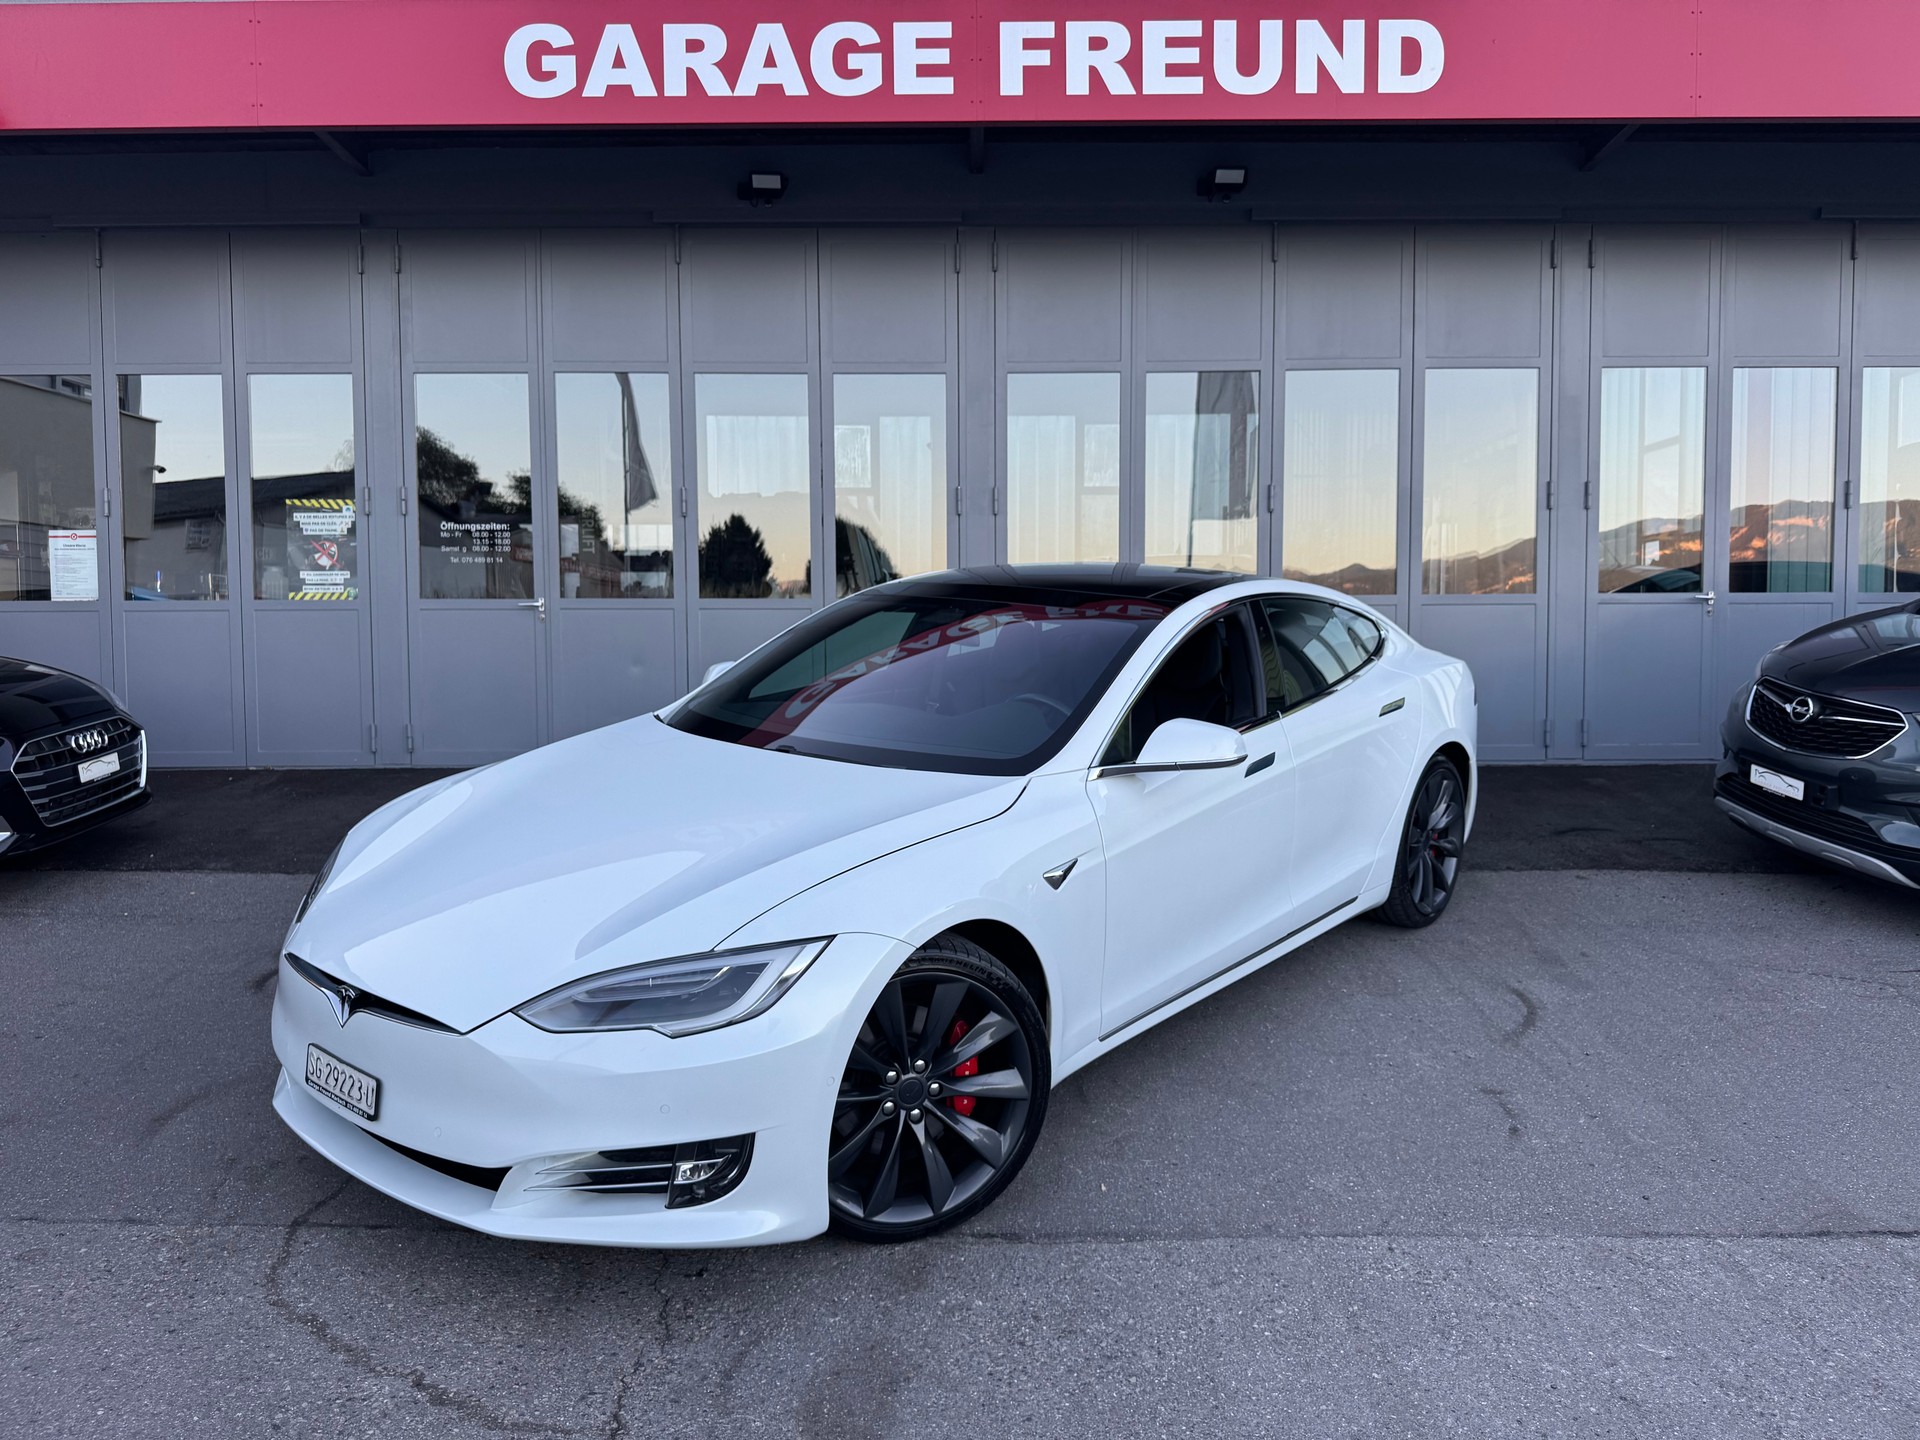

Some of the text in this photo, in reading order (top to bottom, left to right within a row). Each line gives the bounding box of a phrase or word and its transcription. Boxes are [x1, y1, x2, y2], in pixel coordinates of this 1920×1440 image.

[503, 18, 1446, 99] GARAGE FREUND
[440, 521, 510, 531] Öffnungszeiten:
